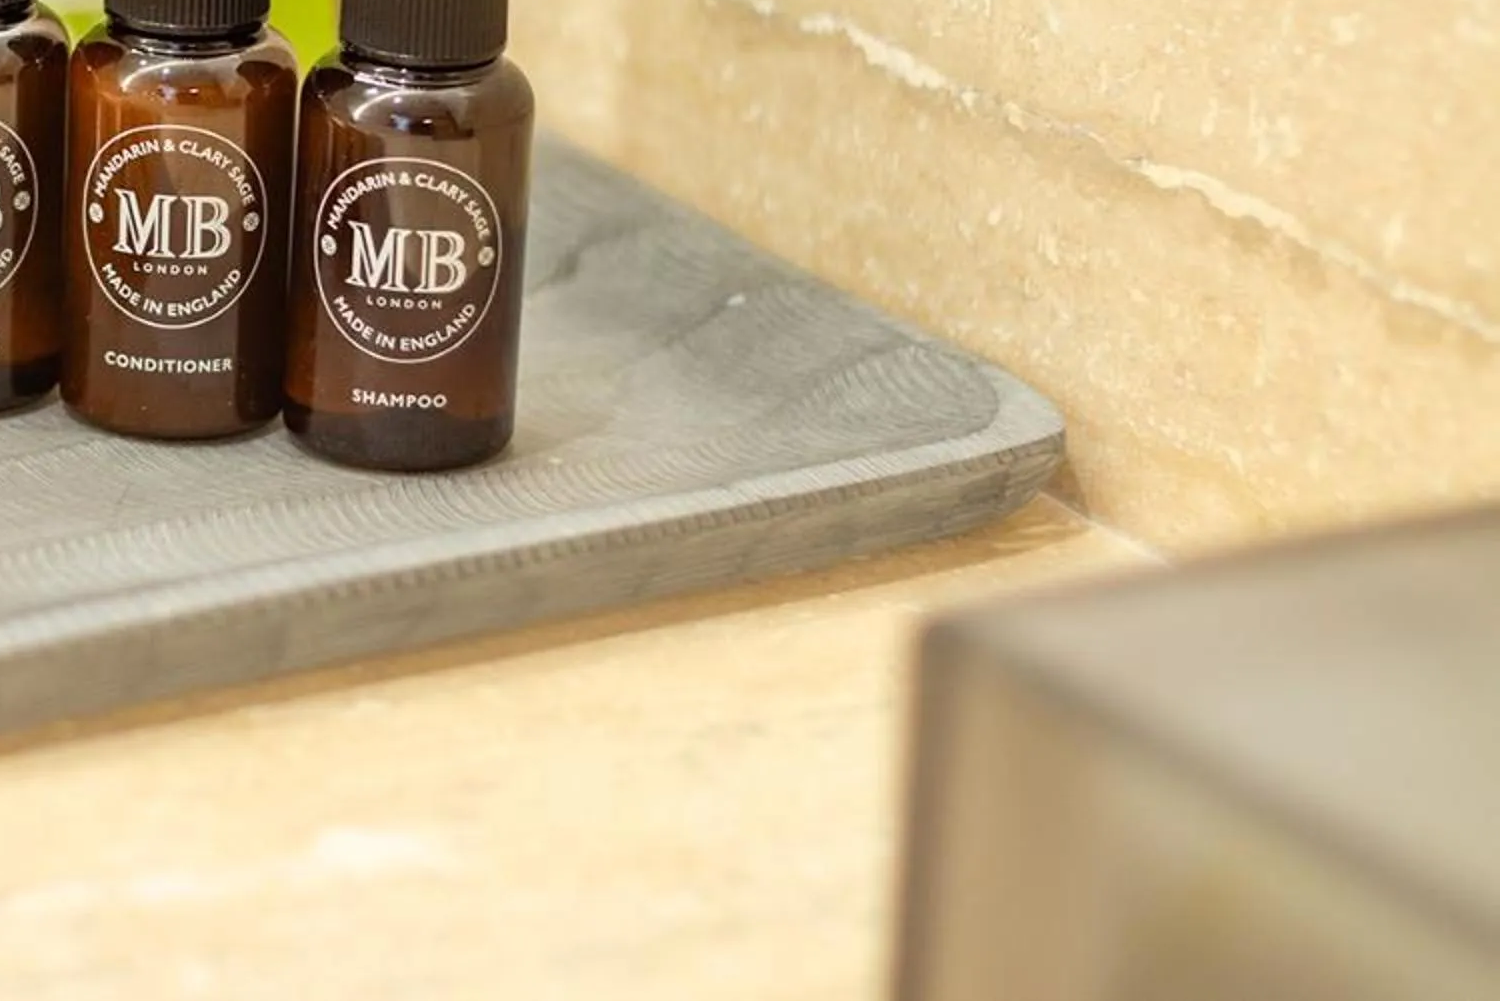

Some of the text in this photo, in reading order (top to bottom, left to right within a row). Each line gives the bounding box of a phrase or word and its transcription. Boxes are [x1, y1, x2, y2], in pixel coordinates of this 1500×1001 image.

[94, 138, 257, 207] MANDARIN & CLARY SAGE
[112, 187, 233, 259] MB
[327, 171, 492, 242] MANDARIN & CLARY SAGE
[133, 261, 208, 276] LONDON
[345, 220, 467, 294] MB
[101, 262, 242, 317] MADE IN ENGLAND
[366, 294, 443, 309] LONDON
[333, 295, 476, 351] MADE IN ENGLAND
[104, 351, 233, 374] CONDITIONER
[351, 388, 448, 409] SHAMPOO
